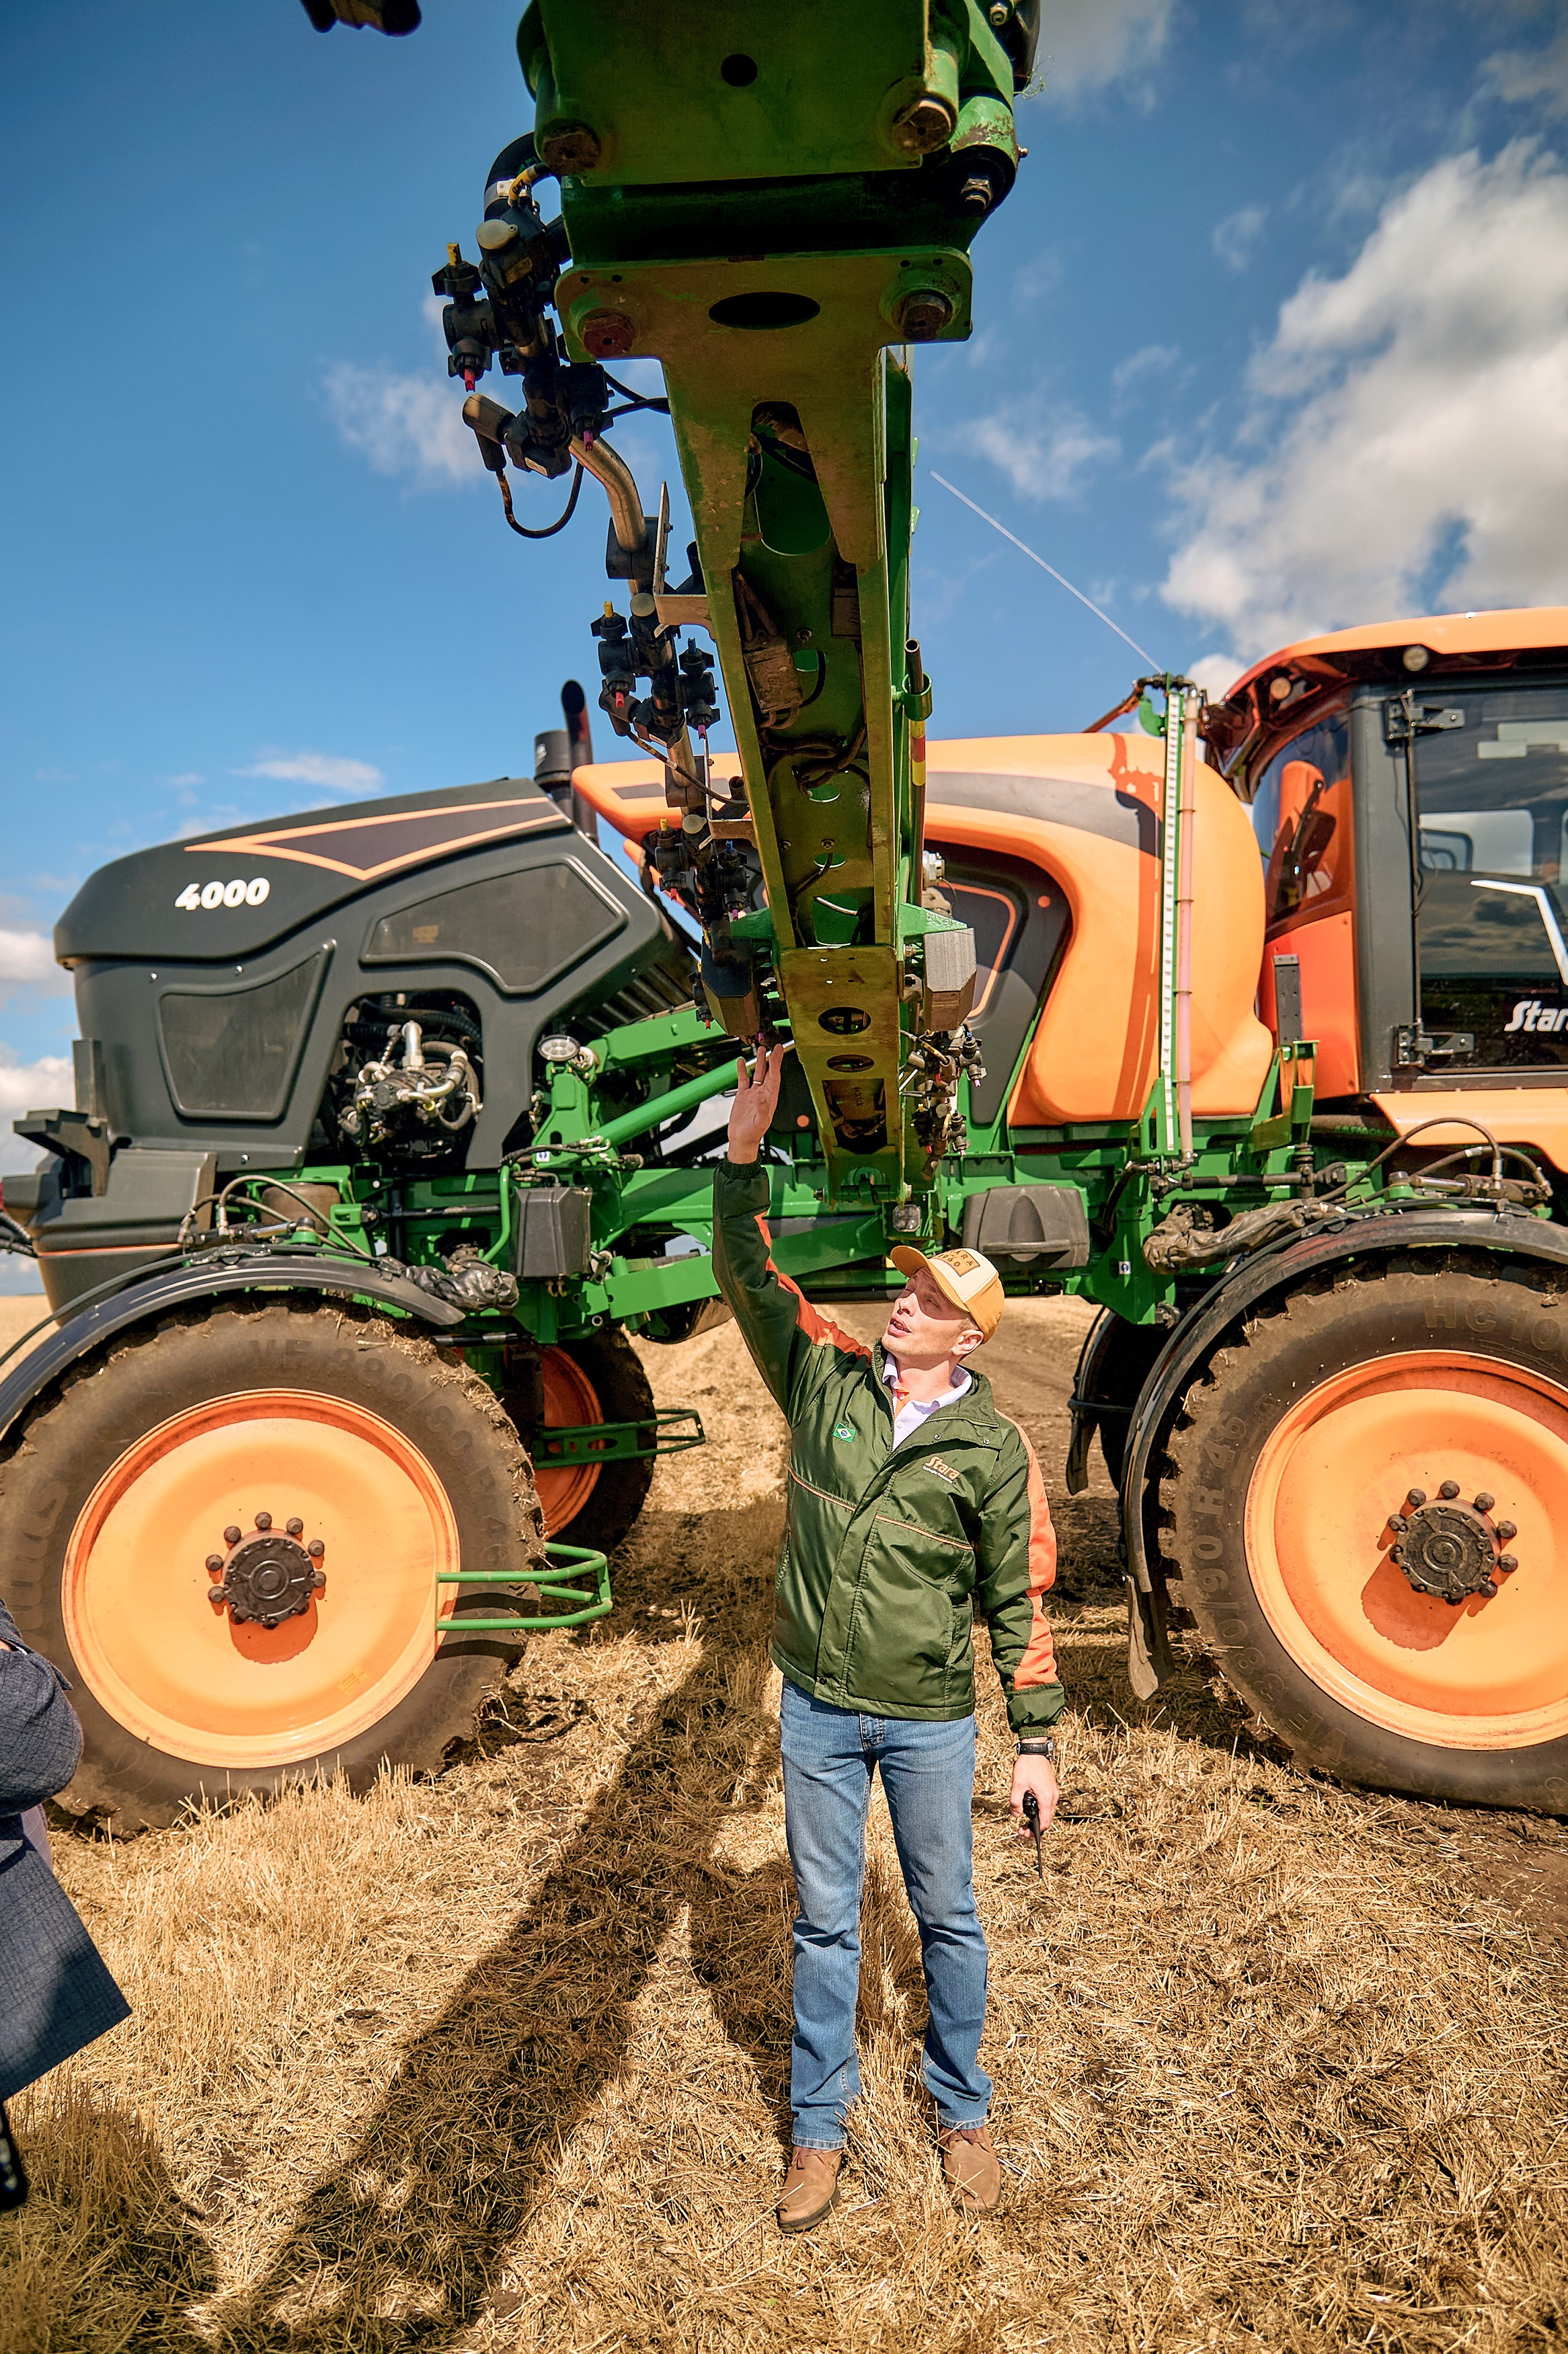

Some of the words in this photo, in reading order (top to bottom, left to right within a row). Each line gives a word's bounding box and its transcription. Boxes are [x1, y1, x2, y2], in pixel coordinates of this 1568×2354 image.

[175, 877, 270, 911] 4000
[1504, 1000, 1568, 1032] Star
[925, 1455, 960, 1480] Stara
